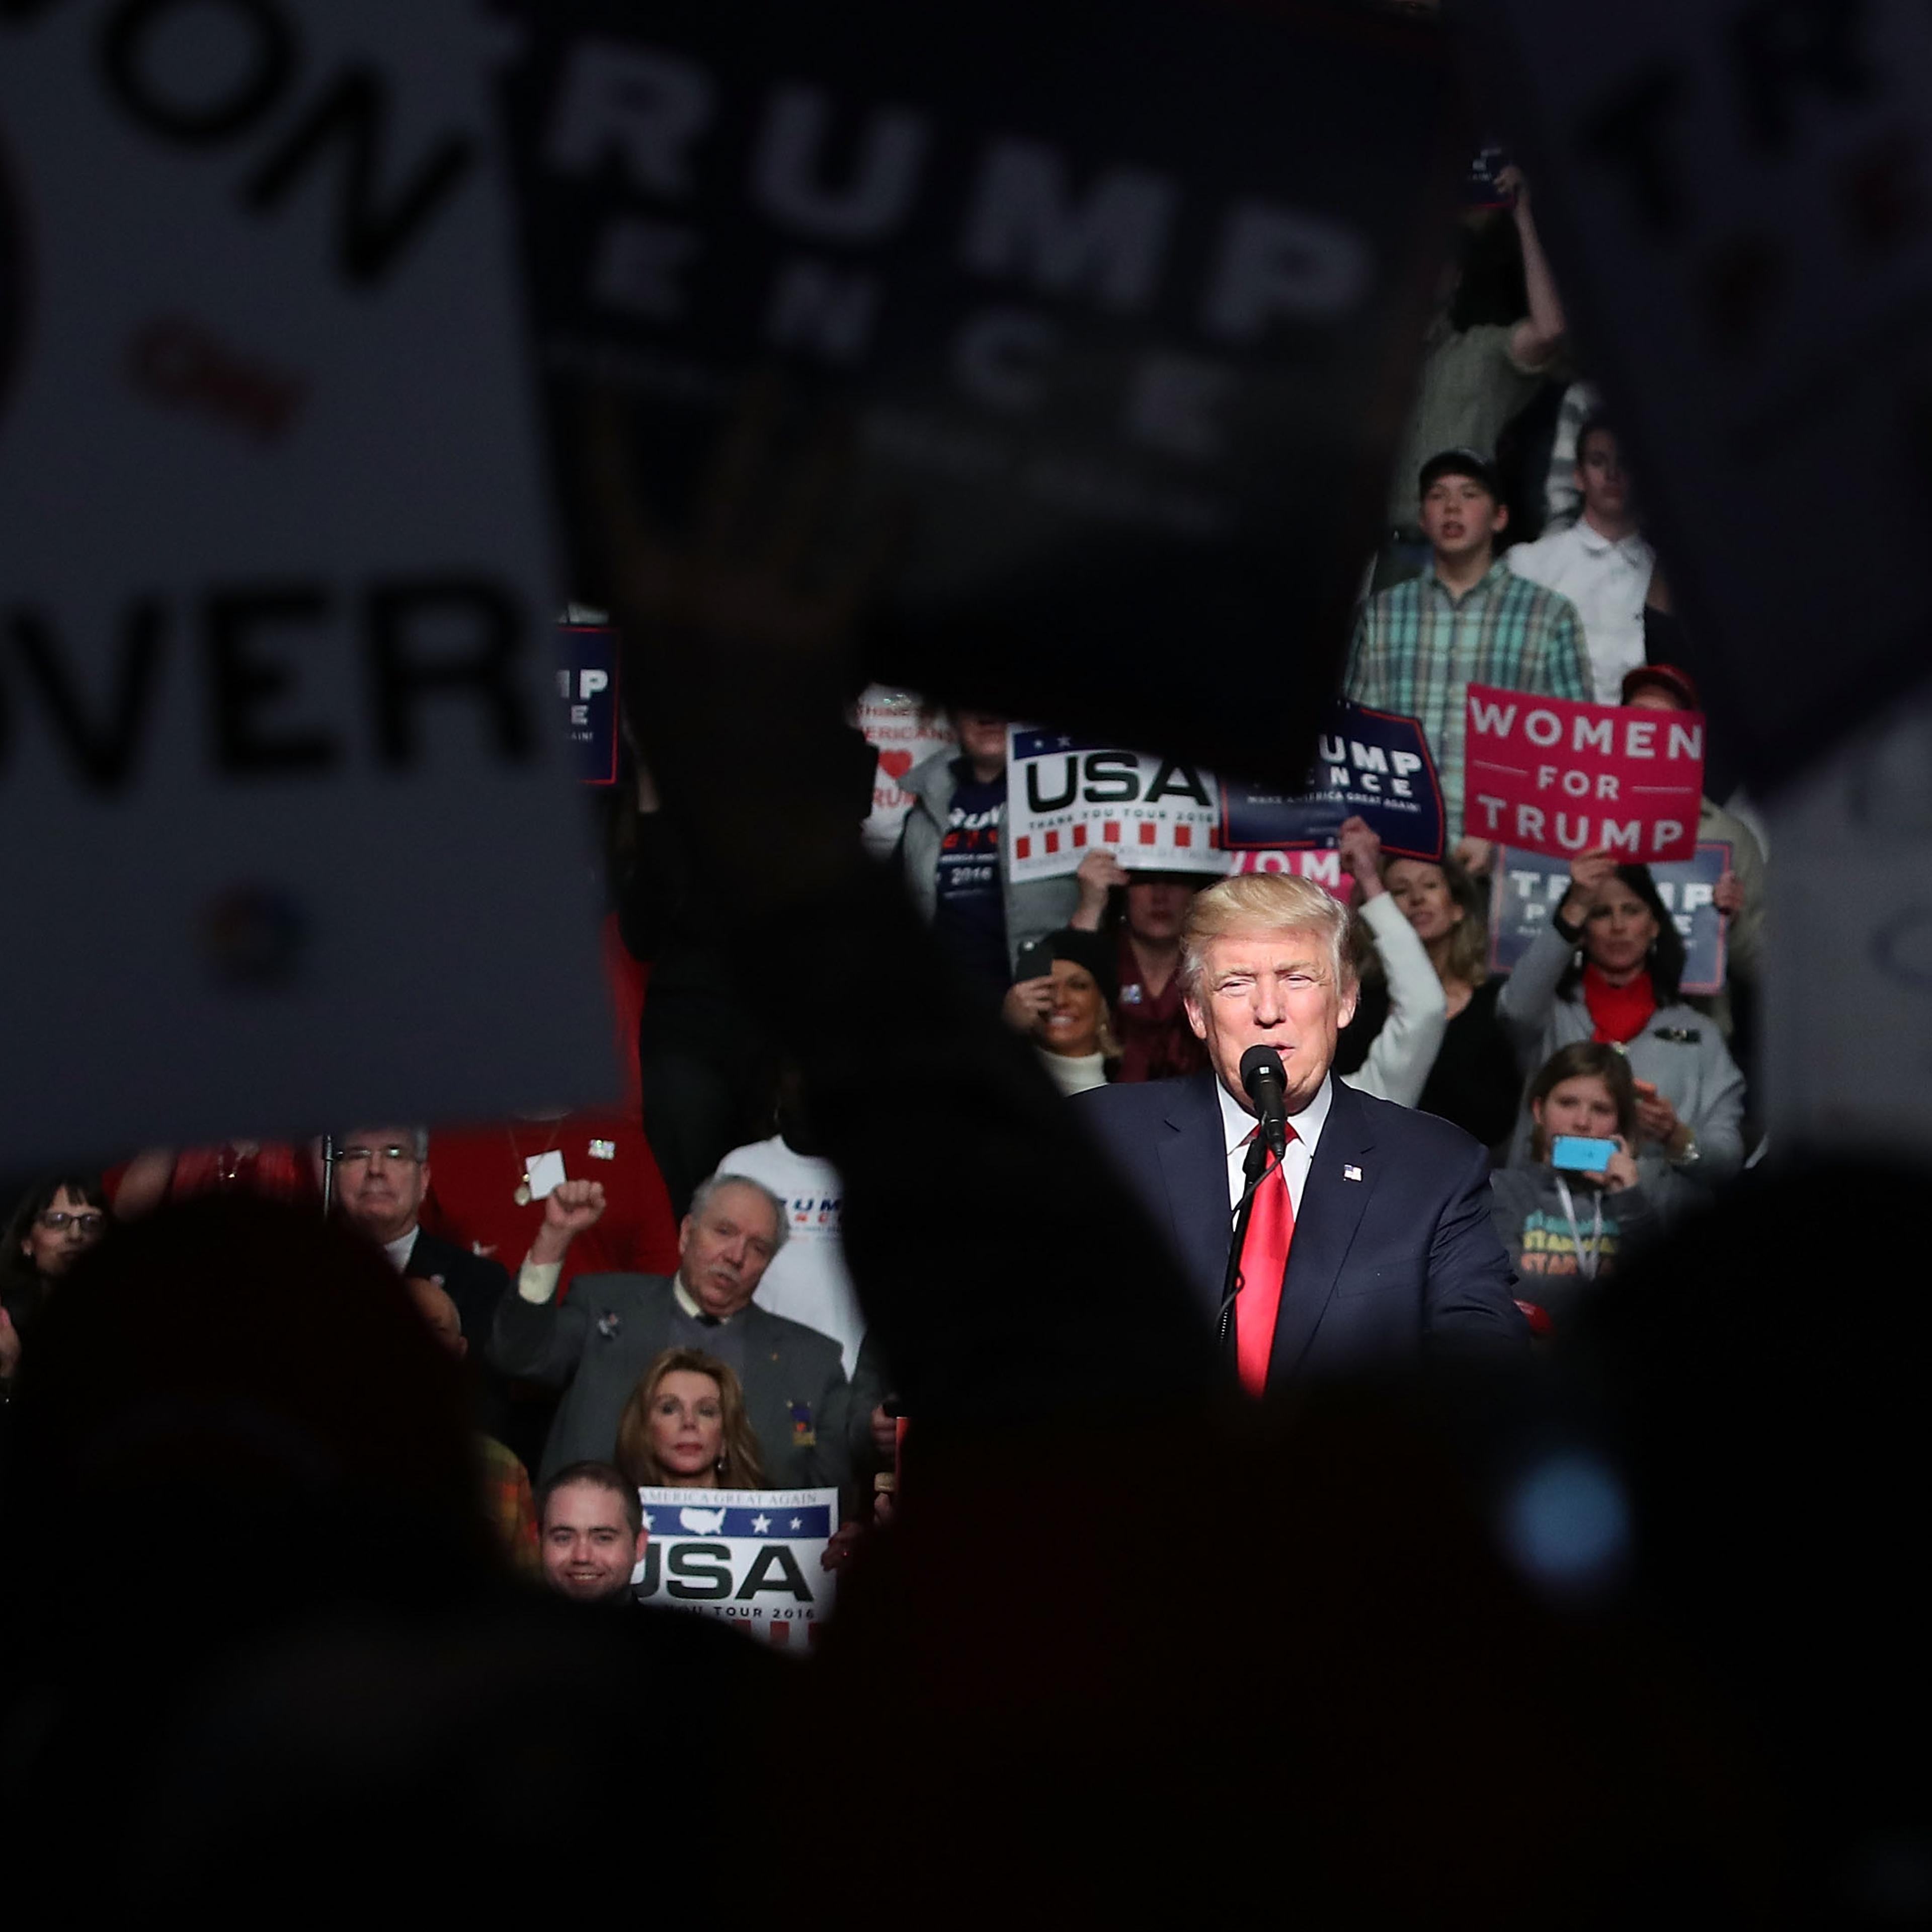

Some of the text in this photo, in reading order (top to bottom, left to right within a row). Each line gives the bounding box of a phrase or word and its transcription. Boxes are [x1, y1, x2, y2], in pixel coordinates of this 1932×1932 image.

[75, 0, 486, 289] ON
[508, 25, 1381, 345] RUMP
[581, 209, 1245, 463] ENCE
[0, 569, 536, 792] VER
[1319, 733, 1423, 778] UMP
[1469, 696, 1704, 760] WOMEN
[1025, 750, 1214, 813] USA
[1318, 765, 1414, 798] NCE
[1537, 764, 1620, 801] FOR
[1028, 814, 1074, 830] THANK
[1083, 808, 1114, 820] YOU
[1124, 808, 1167, 820] TOUR
[1475, 793, 1684, 854] TRUMP
[713, 1492, 765, 1504] GREAT
[770, 1492, 818, 1504] AGAIN
[712, 1606, 762, 1619] TOUR
[772, 1608, 815, 1620] 2016
